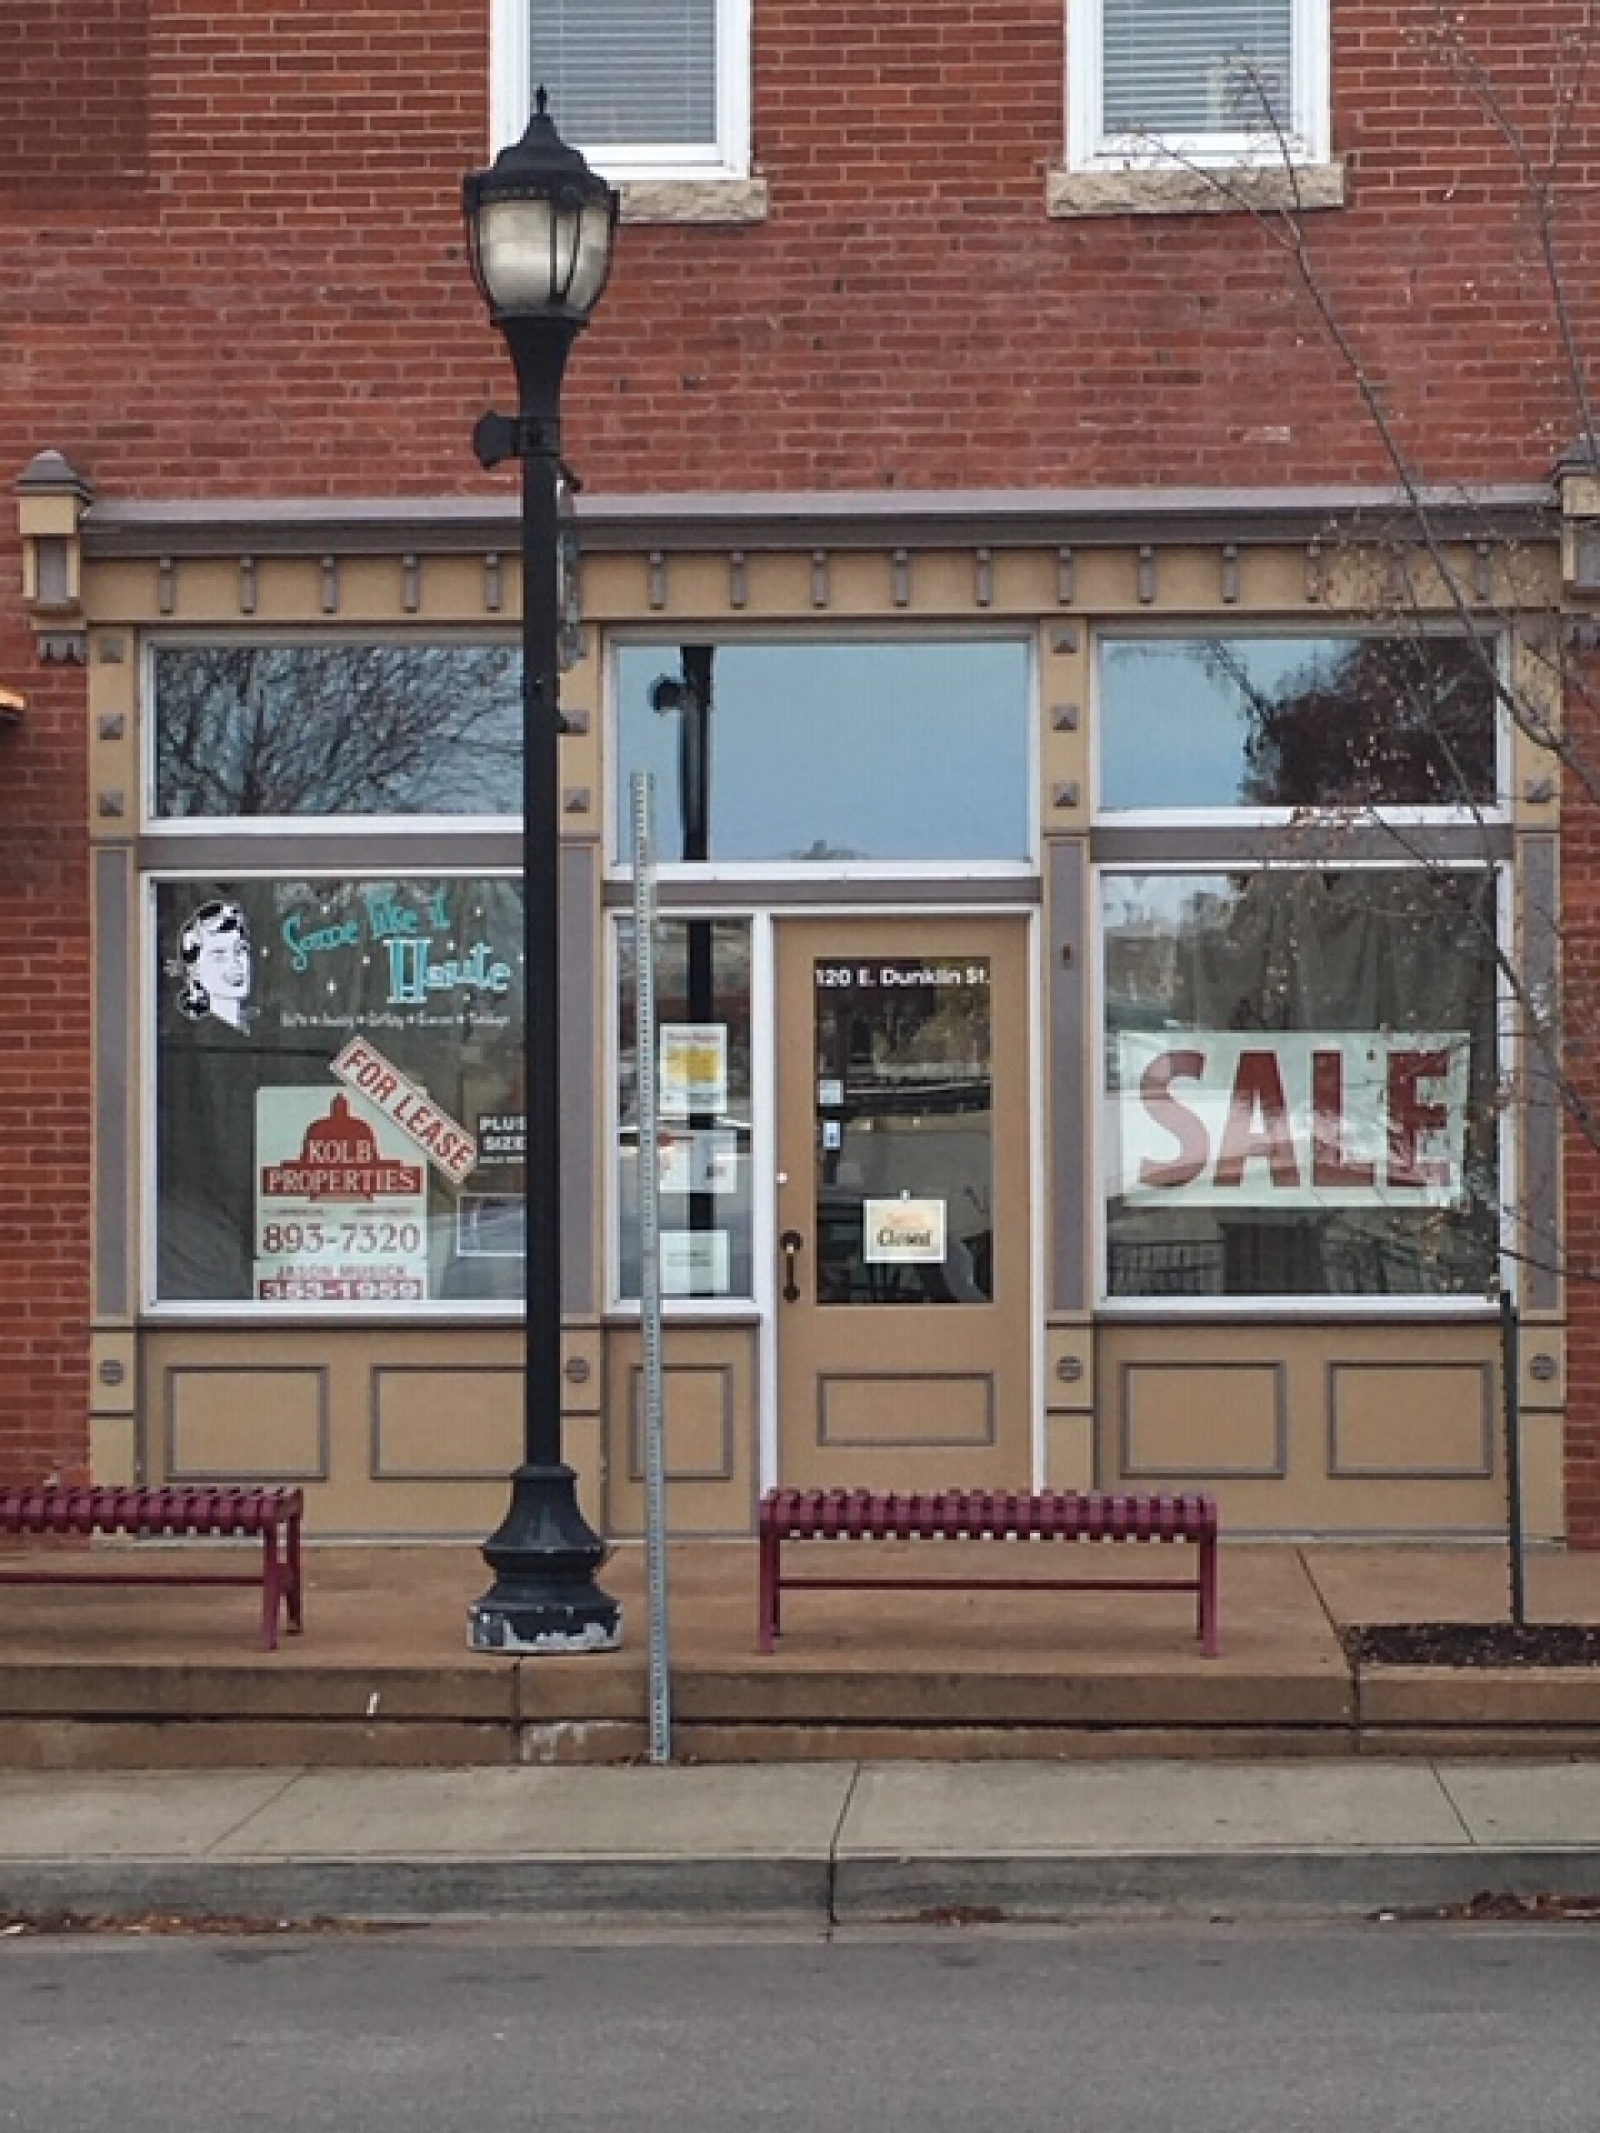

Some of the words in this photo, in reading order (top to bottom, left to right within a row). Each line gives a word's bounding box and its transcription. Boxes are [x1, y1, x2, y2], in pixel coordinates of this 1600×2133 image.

[815, 967, 851, 986] 120
[880, 966, 961, 986] Dunklin
[343, 1049, 398, 1104] FOR
[393, 1093, 474, 1170] LEASE
[1139, 1049, 1451, 1189] SALE
[309, 1139, 372, 1164] KOLB
[268, 1168, 416, 1192] PROPERTIES
[262, 1222, 421, 1254] 893-7320
